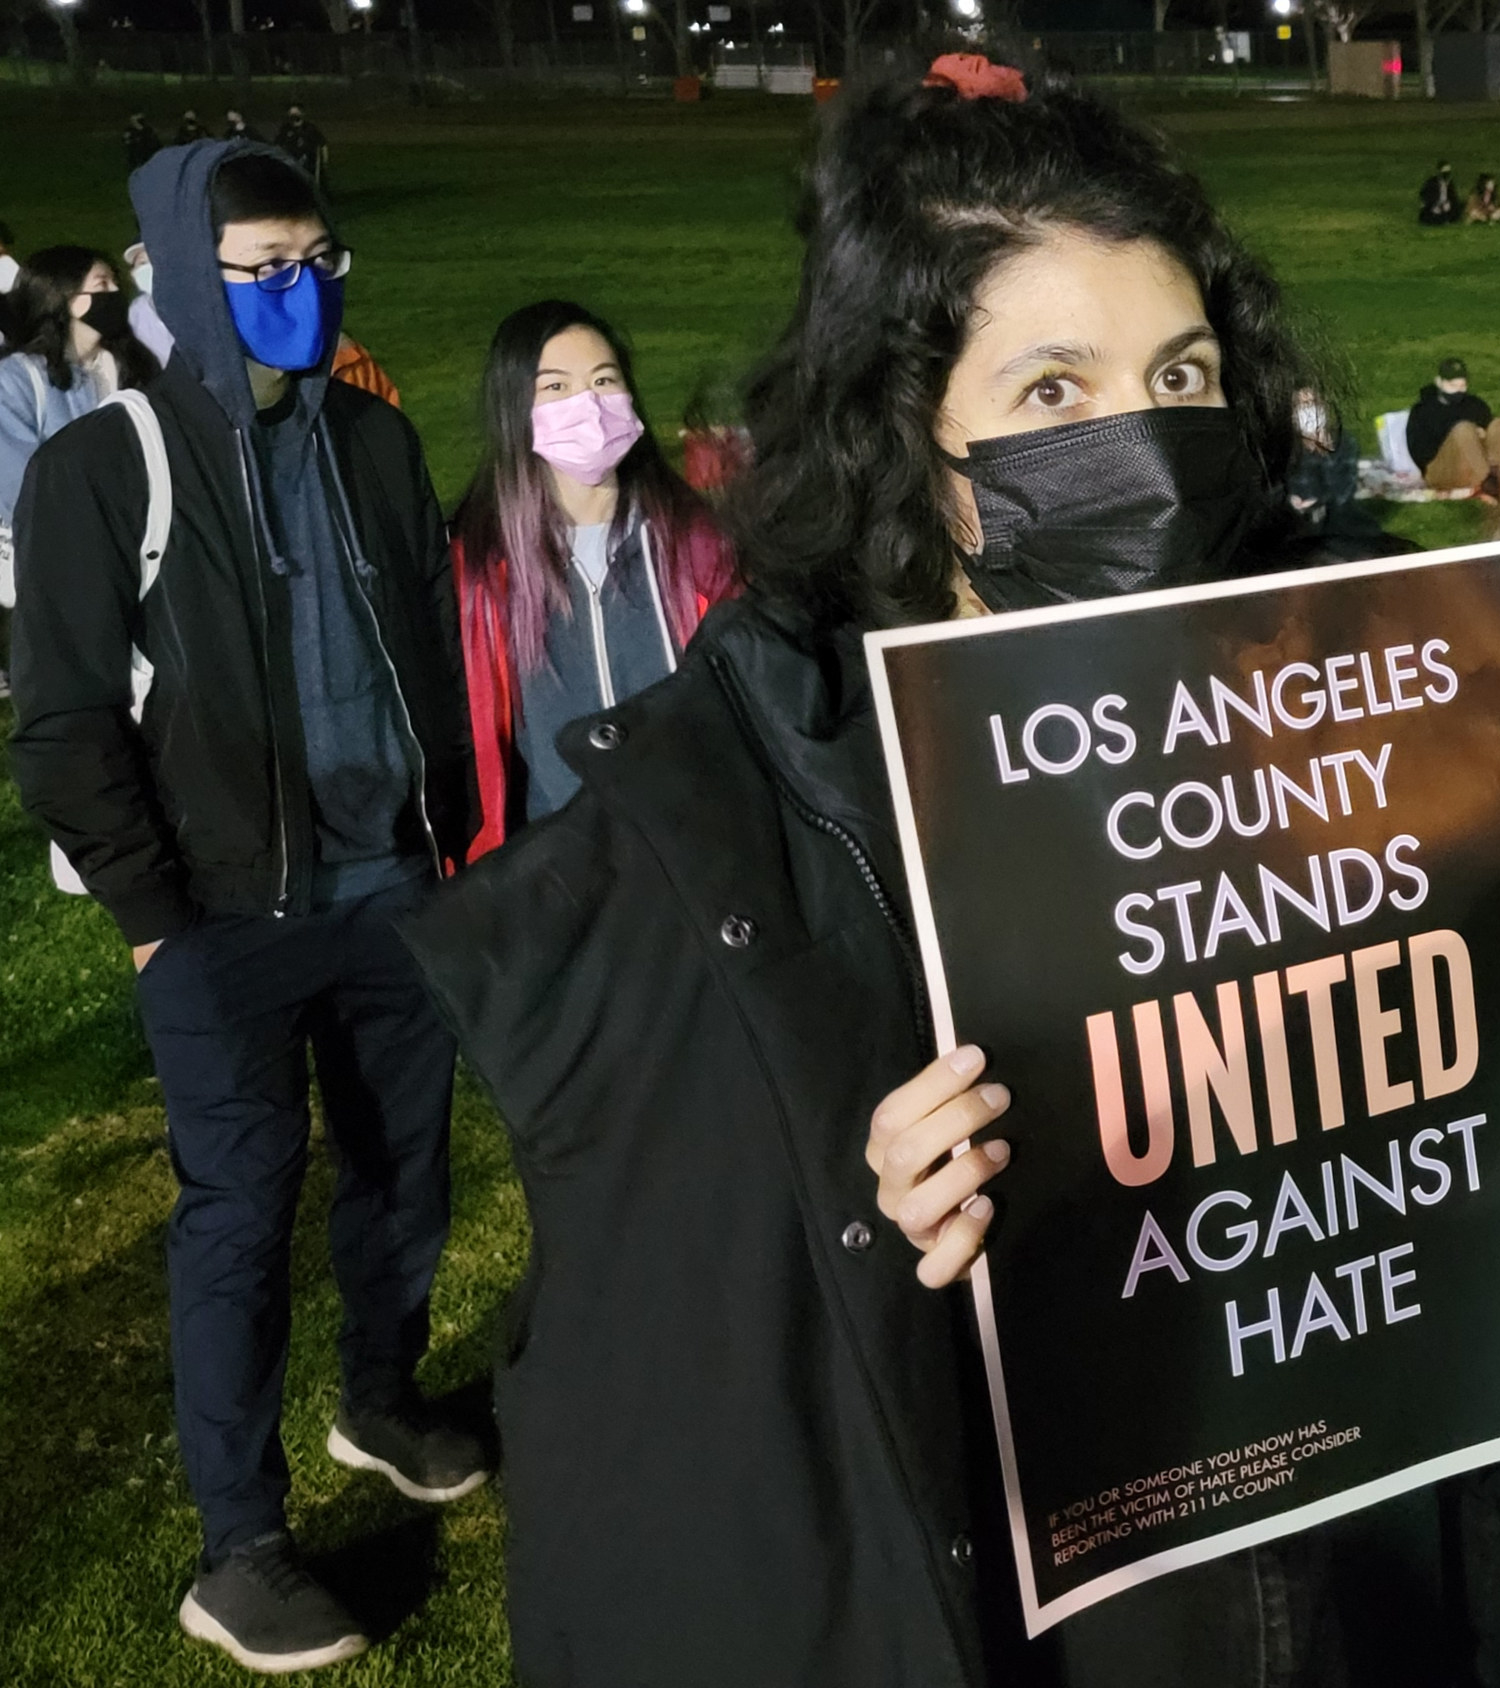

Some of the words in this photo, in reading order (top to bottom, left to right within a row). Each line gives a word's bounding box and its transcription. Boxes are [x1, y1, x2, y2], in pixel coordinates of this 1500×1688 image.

[989, 693, 1137, 785] LOS
[1162, 638, 1459, 755] ANGELES
[1106, 743, 1393, 861] COUNTY
[1114, 833, 1430, 976] STANDS
[1086, 929, 1479, 1187] UNITED
[1122, 1114, 1487, 1299] AGAINST
[1225, 1242, 1422, 1377] HATE
[1048, 1512, 1061, 1529] IF
[1063, 1497, 1095, 1520] YOU
[1099, 1487, 1121, 1506] OR
[1125, 1460, 1204, 1497] SOMEONE
[1207, 1448, 1241, 1470] YOU
[1244, 1430, 1295, 1460] KNOW
[1298, 1419, 1328, 1441] HAS
[1051, 1520, 1087, 1548] BEEN
[1090, 1507, 1117, 1529] THE
[1120, 1489, 1171, 1517] VICTIM
[1174, 1481, 1196, 1499] OF
[1200, 1468, 1237, 1492] HATE
[1240, 1451, 1288, 1480] PLEASE
[1291, 1426, 1362, 1462] CONSIDER
[1054, 1522, 1132, 1567] REPORTING
[1135, 1506, 1176, 1530] WITH
[1179, 1496, 1206, 1518] 211
[1212, 1490, 1231, 1507] LA
[1232, 1467, 1296, 1500] COUNTY
